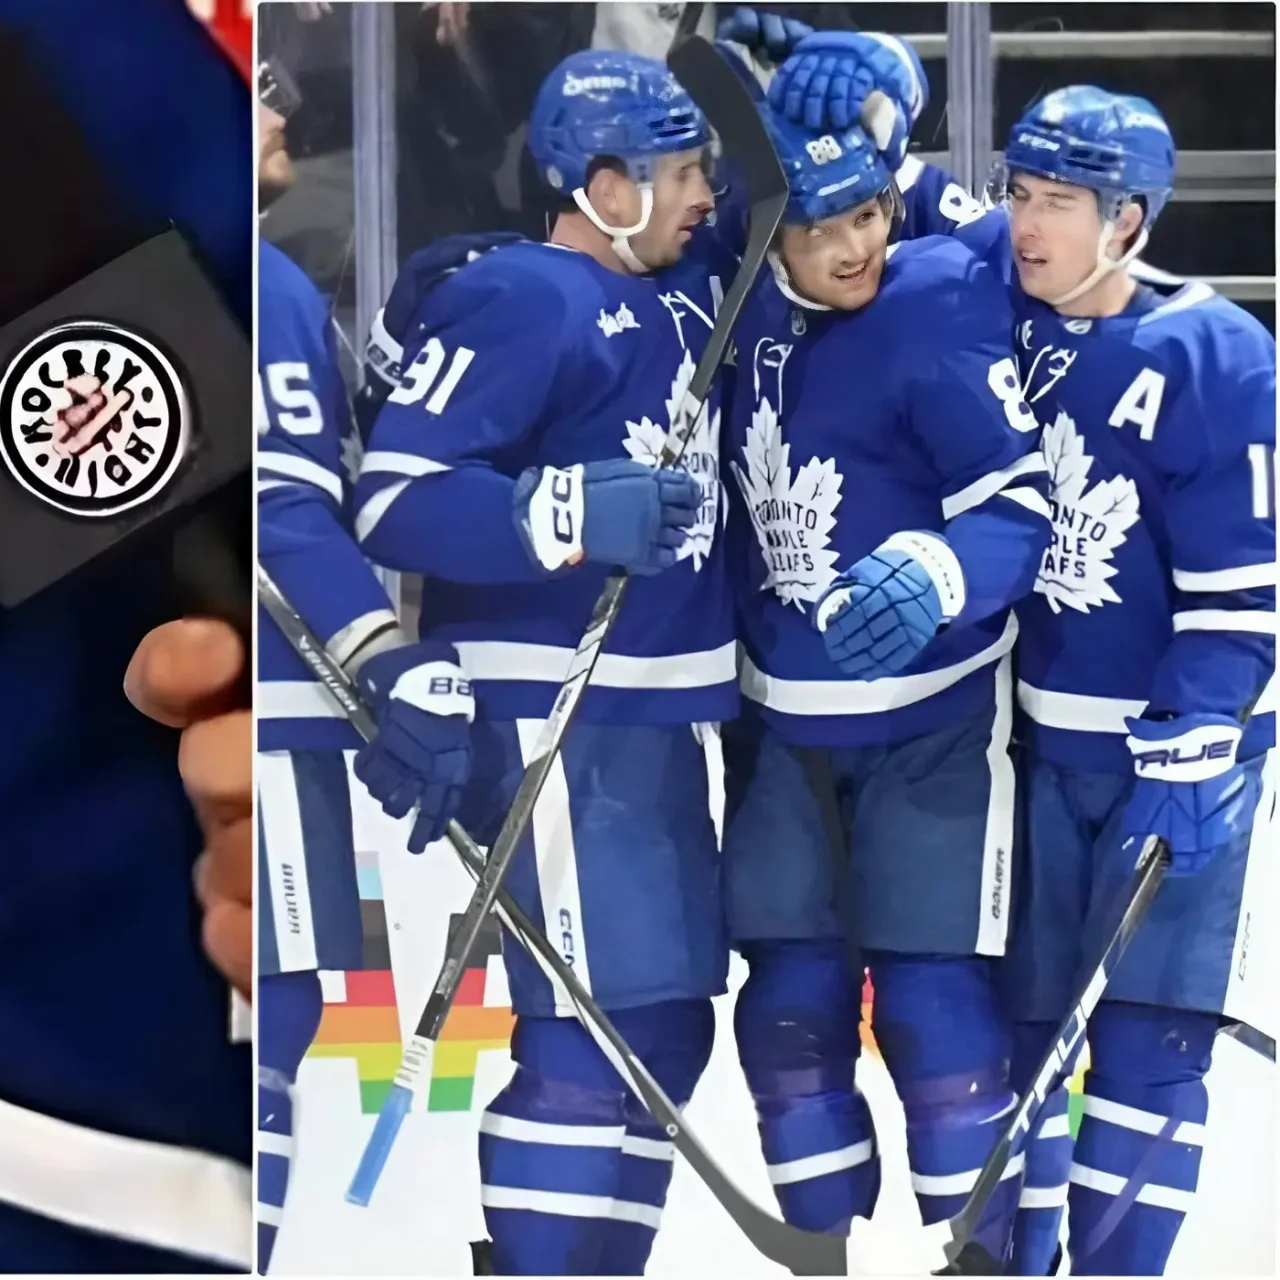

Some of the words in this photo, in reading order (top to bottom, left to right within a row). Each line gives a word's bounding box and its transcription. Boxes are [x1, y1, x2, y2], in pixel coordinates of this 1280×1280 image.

[806, 135, 842, 166] 88
[258, 362, 324, 435] 5
[1108, 367, 1165, 440] A
